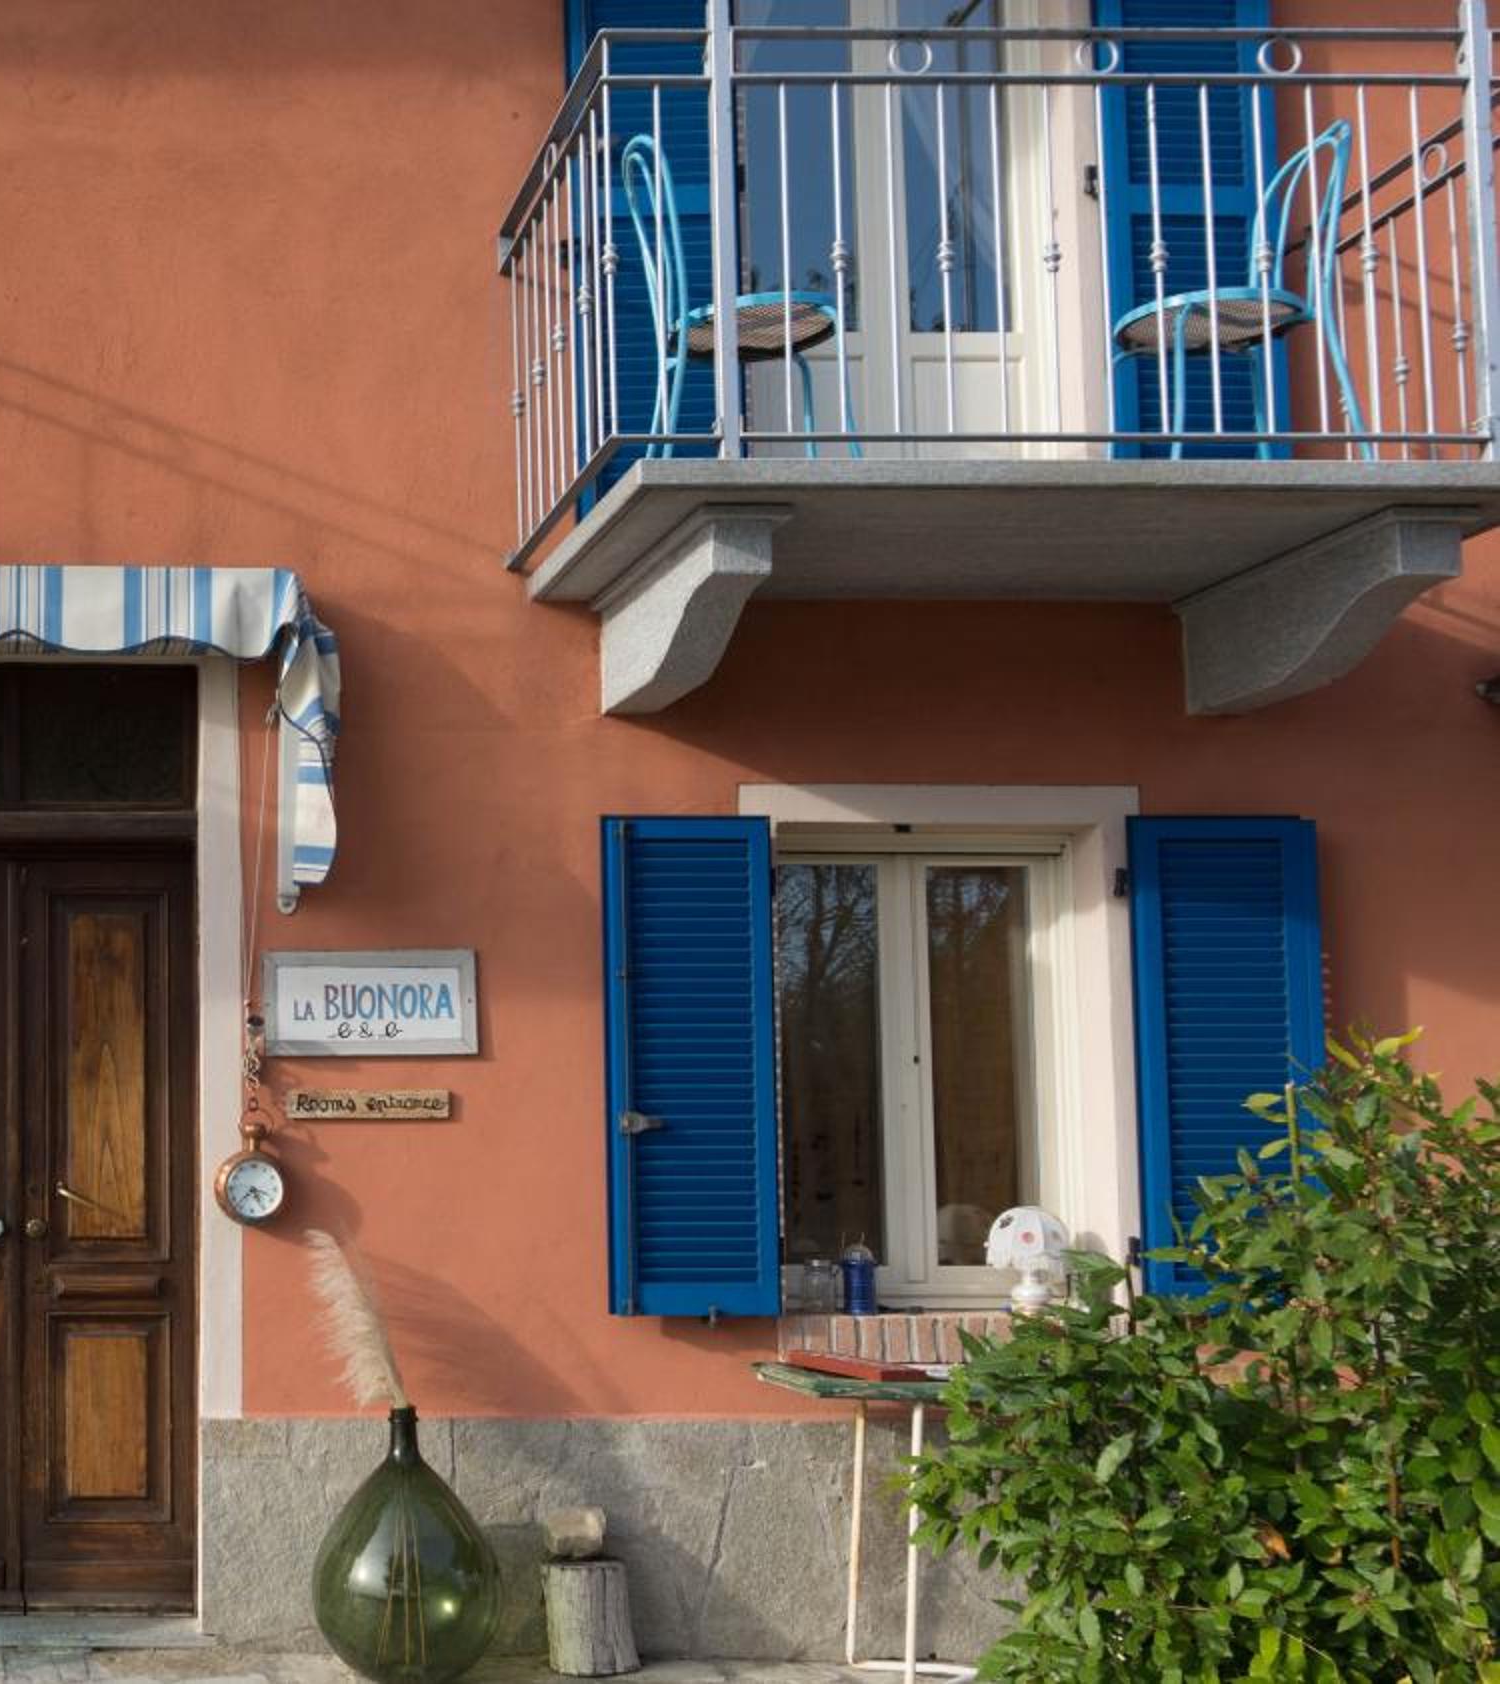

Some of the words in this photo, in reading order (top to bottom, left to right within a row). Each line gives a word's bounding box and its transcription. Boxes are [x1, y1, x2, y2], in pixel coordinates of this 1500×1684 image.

[293, 1000, 315, 1021] LA
[324, 984, 455, 1020] BUONORA
[359, 1021, 374, 1039] &
[296, 1094, 356, 1112] Rooms
[365, 1097, 446, 1112] entrance
